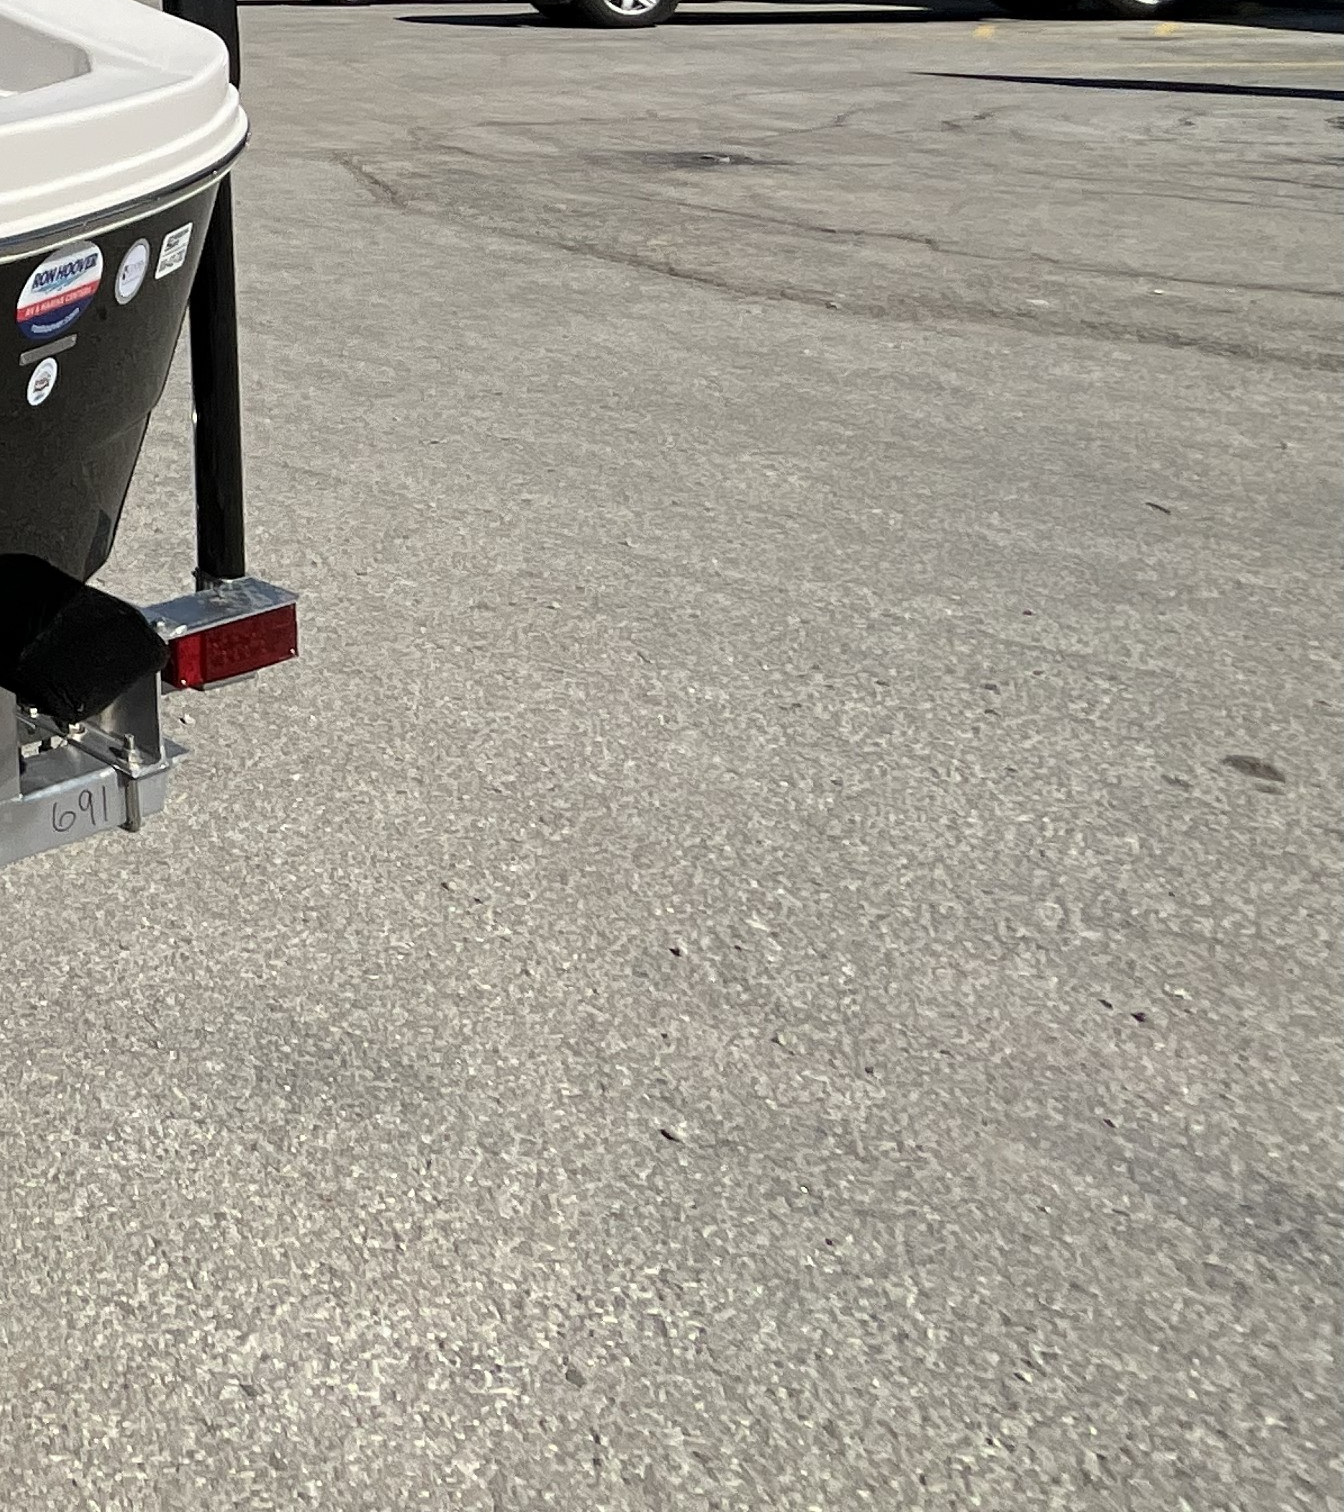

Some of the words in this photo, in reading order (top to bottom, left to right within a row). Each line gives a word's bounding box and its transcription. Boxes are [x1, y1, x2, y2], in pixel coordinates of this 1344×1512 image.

[32, 265, 58, 289] RON
[58, 252, 99, 279] HOOVER
[52, 785, 107, 832] 691
